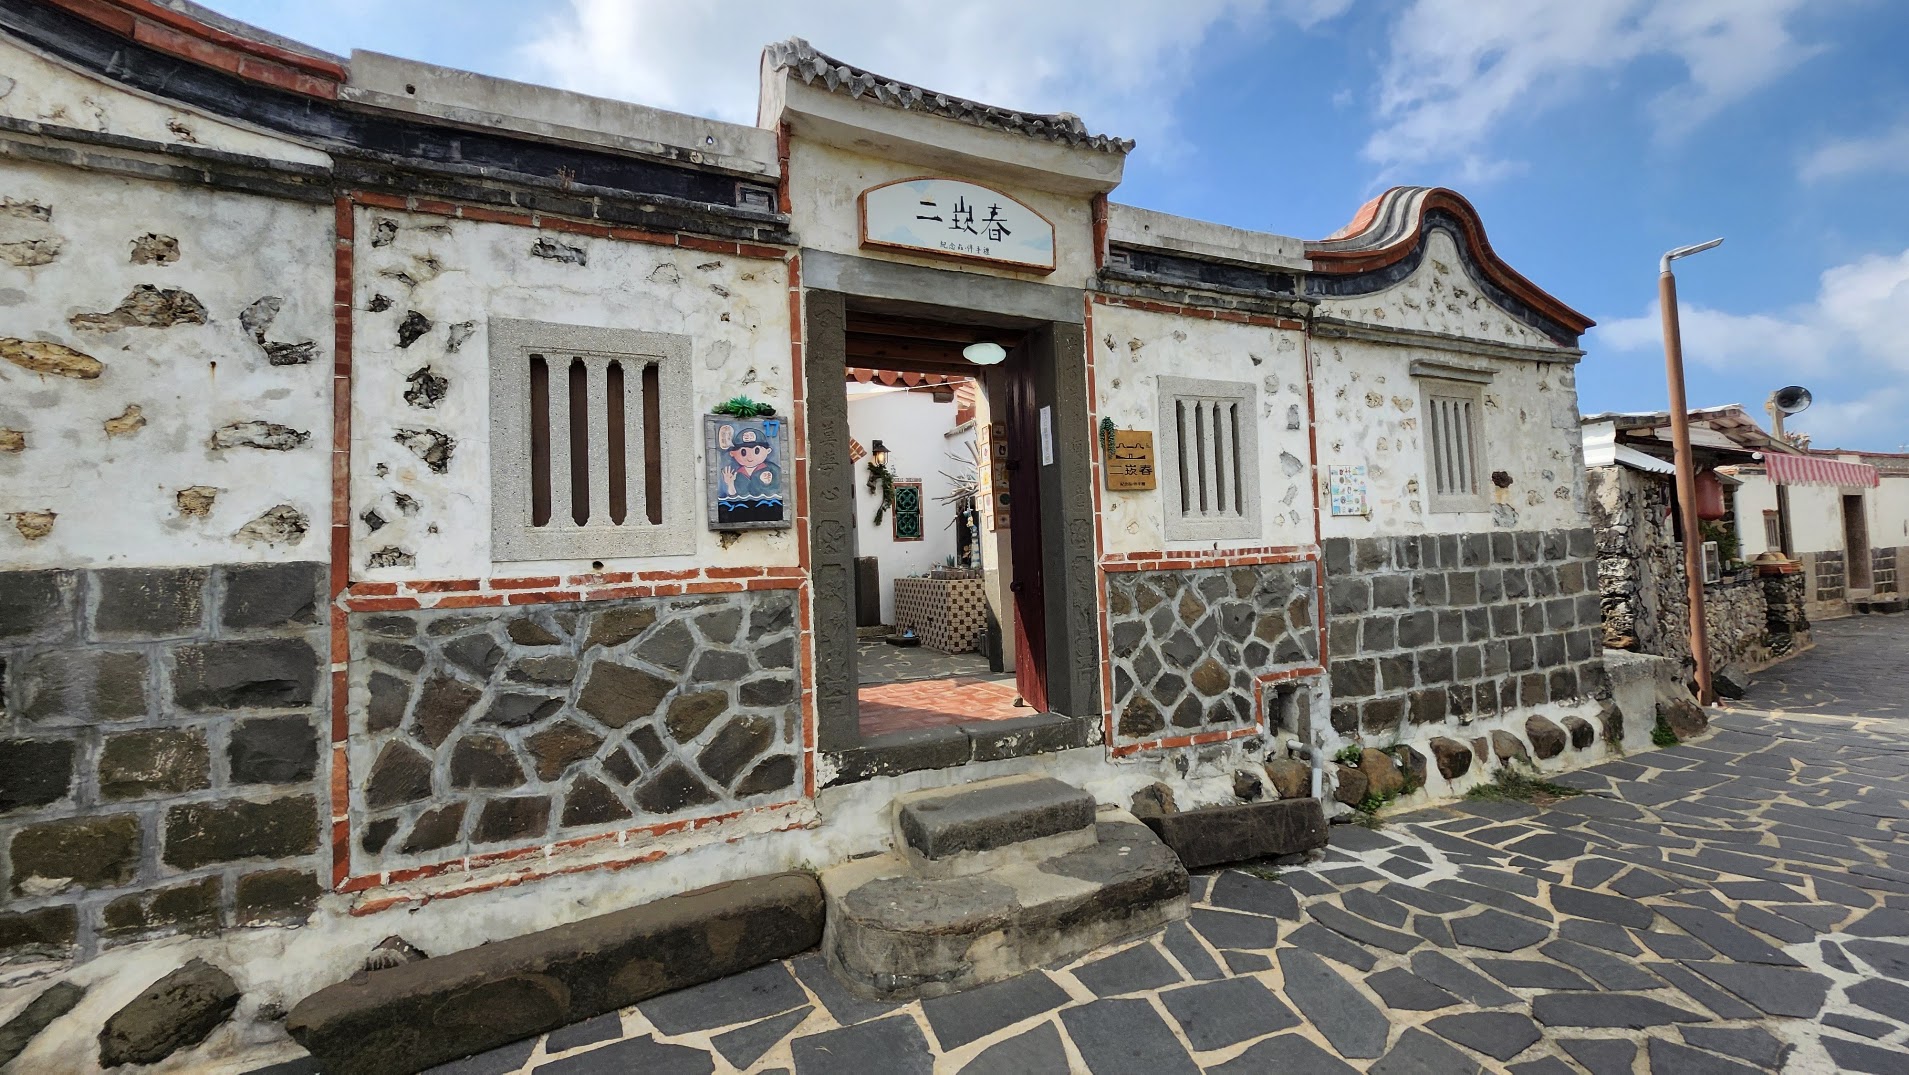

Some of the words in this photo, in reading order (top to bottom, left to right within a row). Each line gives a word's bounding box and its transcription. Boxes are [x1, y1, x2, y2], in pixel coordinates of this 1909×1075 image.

[917, 195, 1011, 242] 二崁春
[763, 421, 780, 437] 17
[1110, 464, 1153, 476] 二崁春
